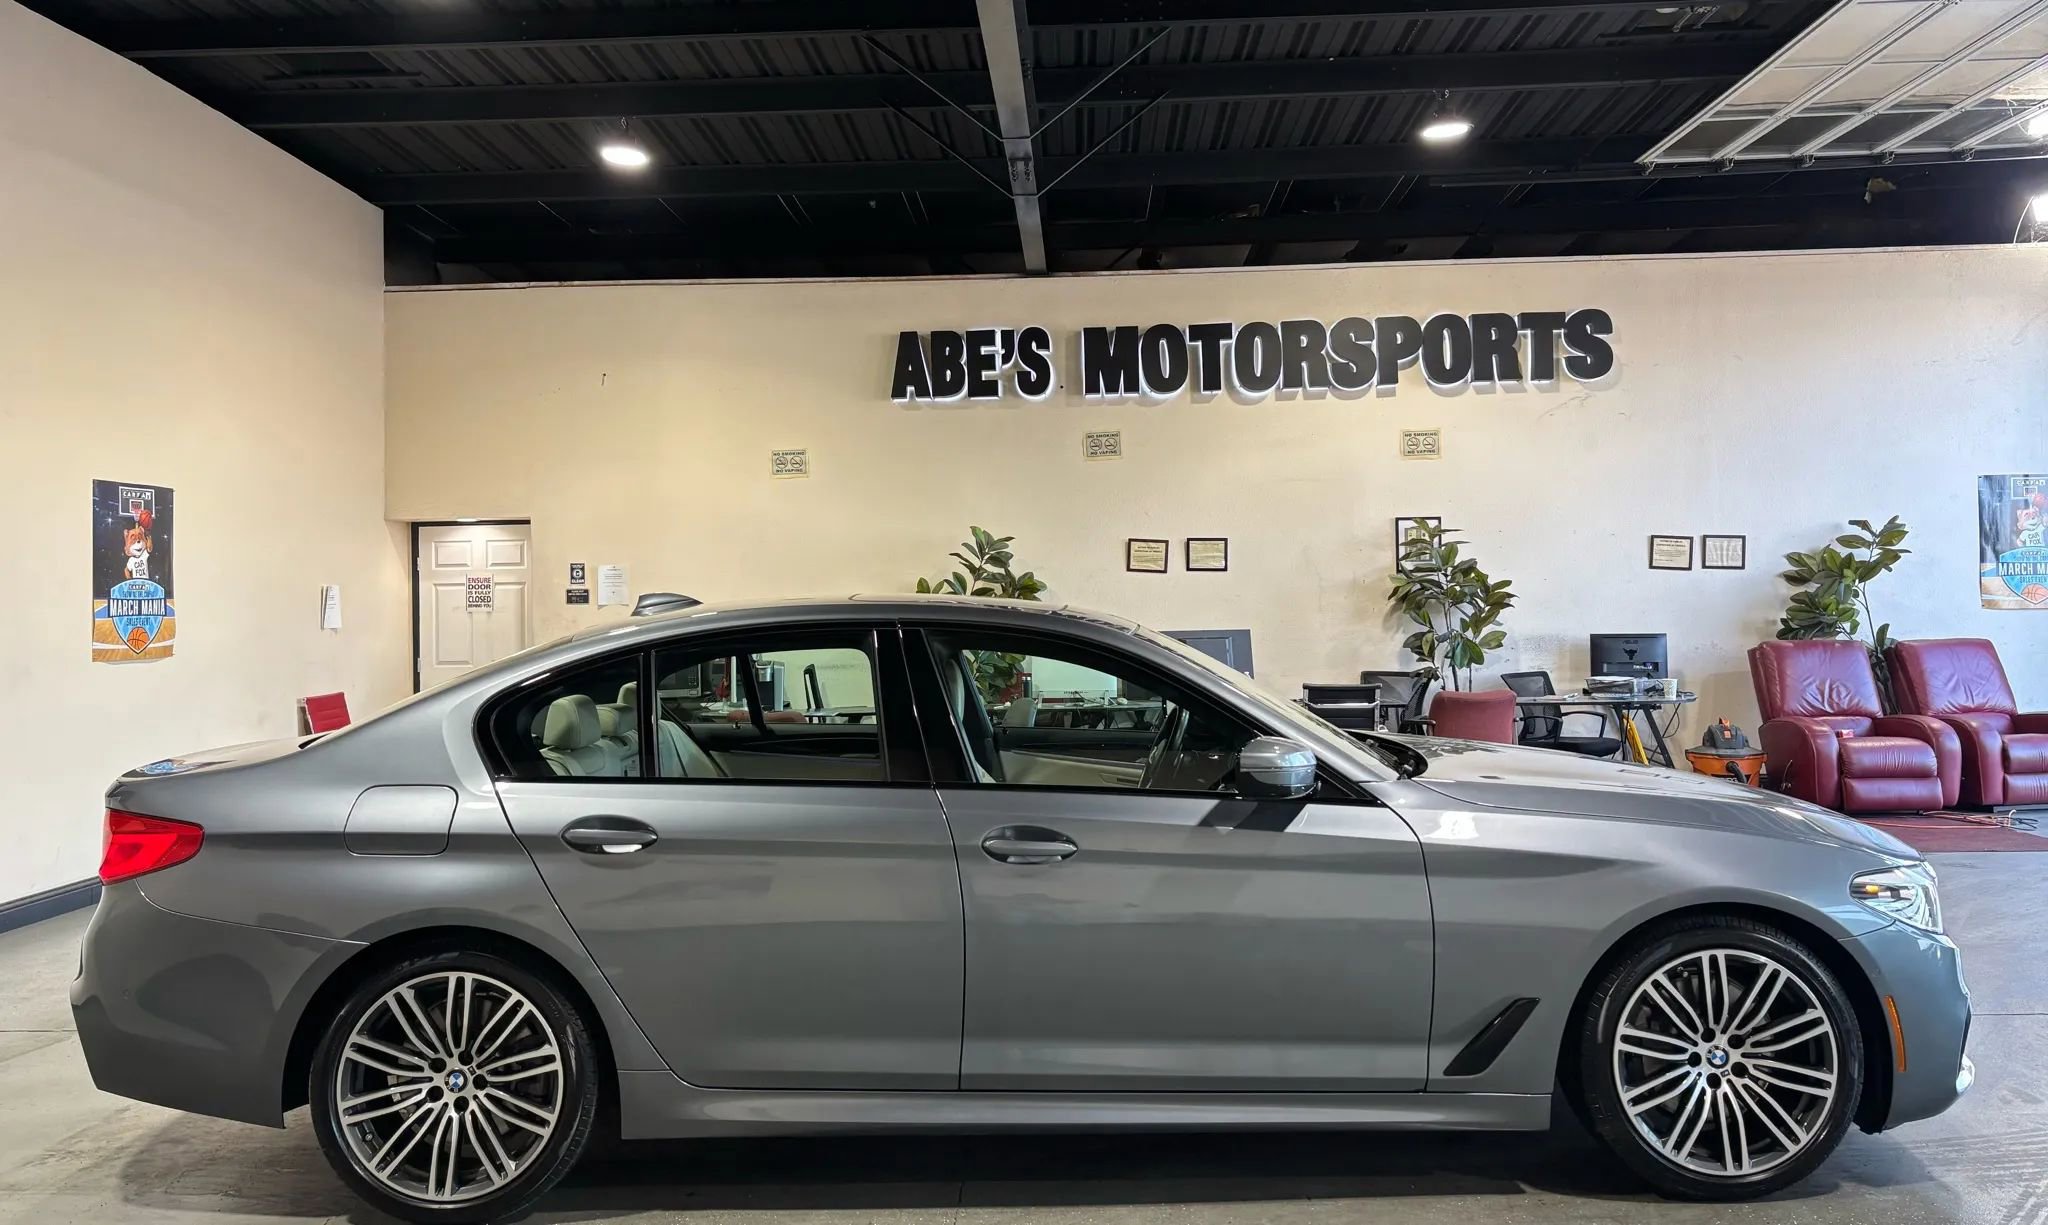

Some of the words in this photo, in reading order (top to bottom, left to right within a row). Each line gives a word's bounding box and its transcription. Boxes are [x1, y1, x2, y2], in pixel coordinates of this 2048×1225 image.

[891, 326, 1052, 399] ABE'S
[1083, 308, 1614, 397] MOTORSPORTS
[134, 560, 145, 568] CAR
[1999, 562, 2033, 576] MARCH
[135, 568, 146, 577] FOX
[468, 595, 492, 603] CLOSED
[110, 599, 139, 616] MARCH
[141, 599, 166, 615] MANIA
